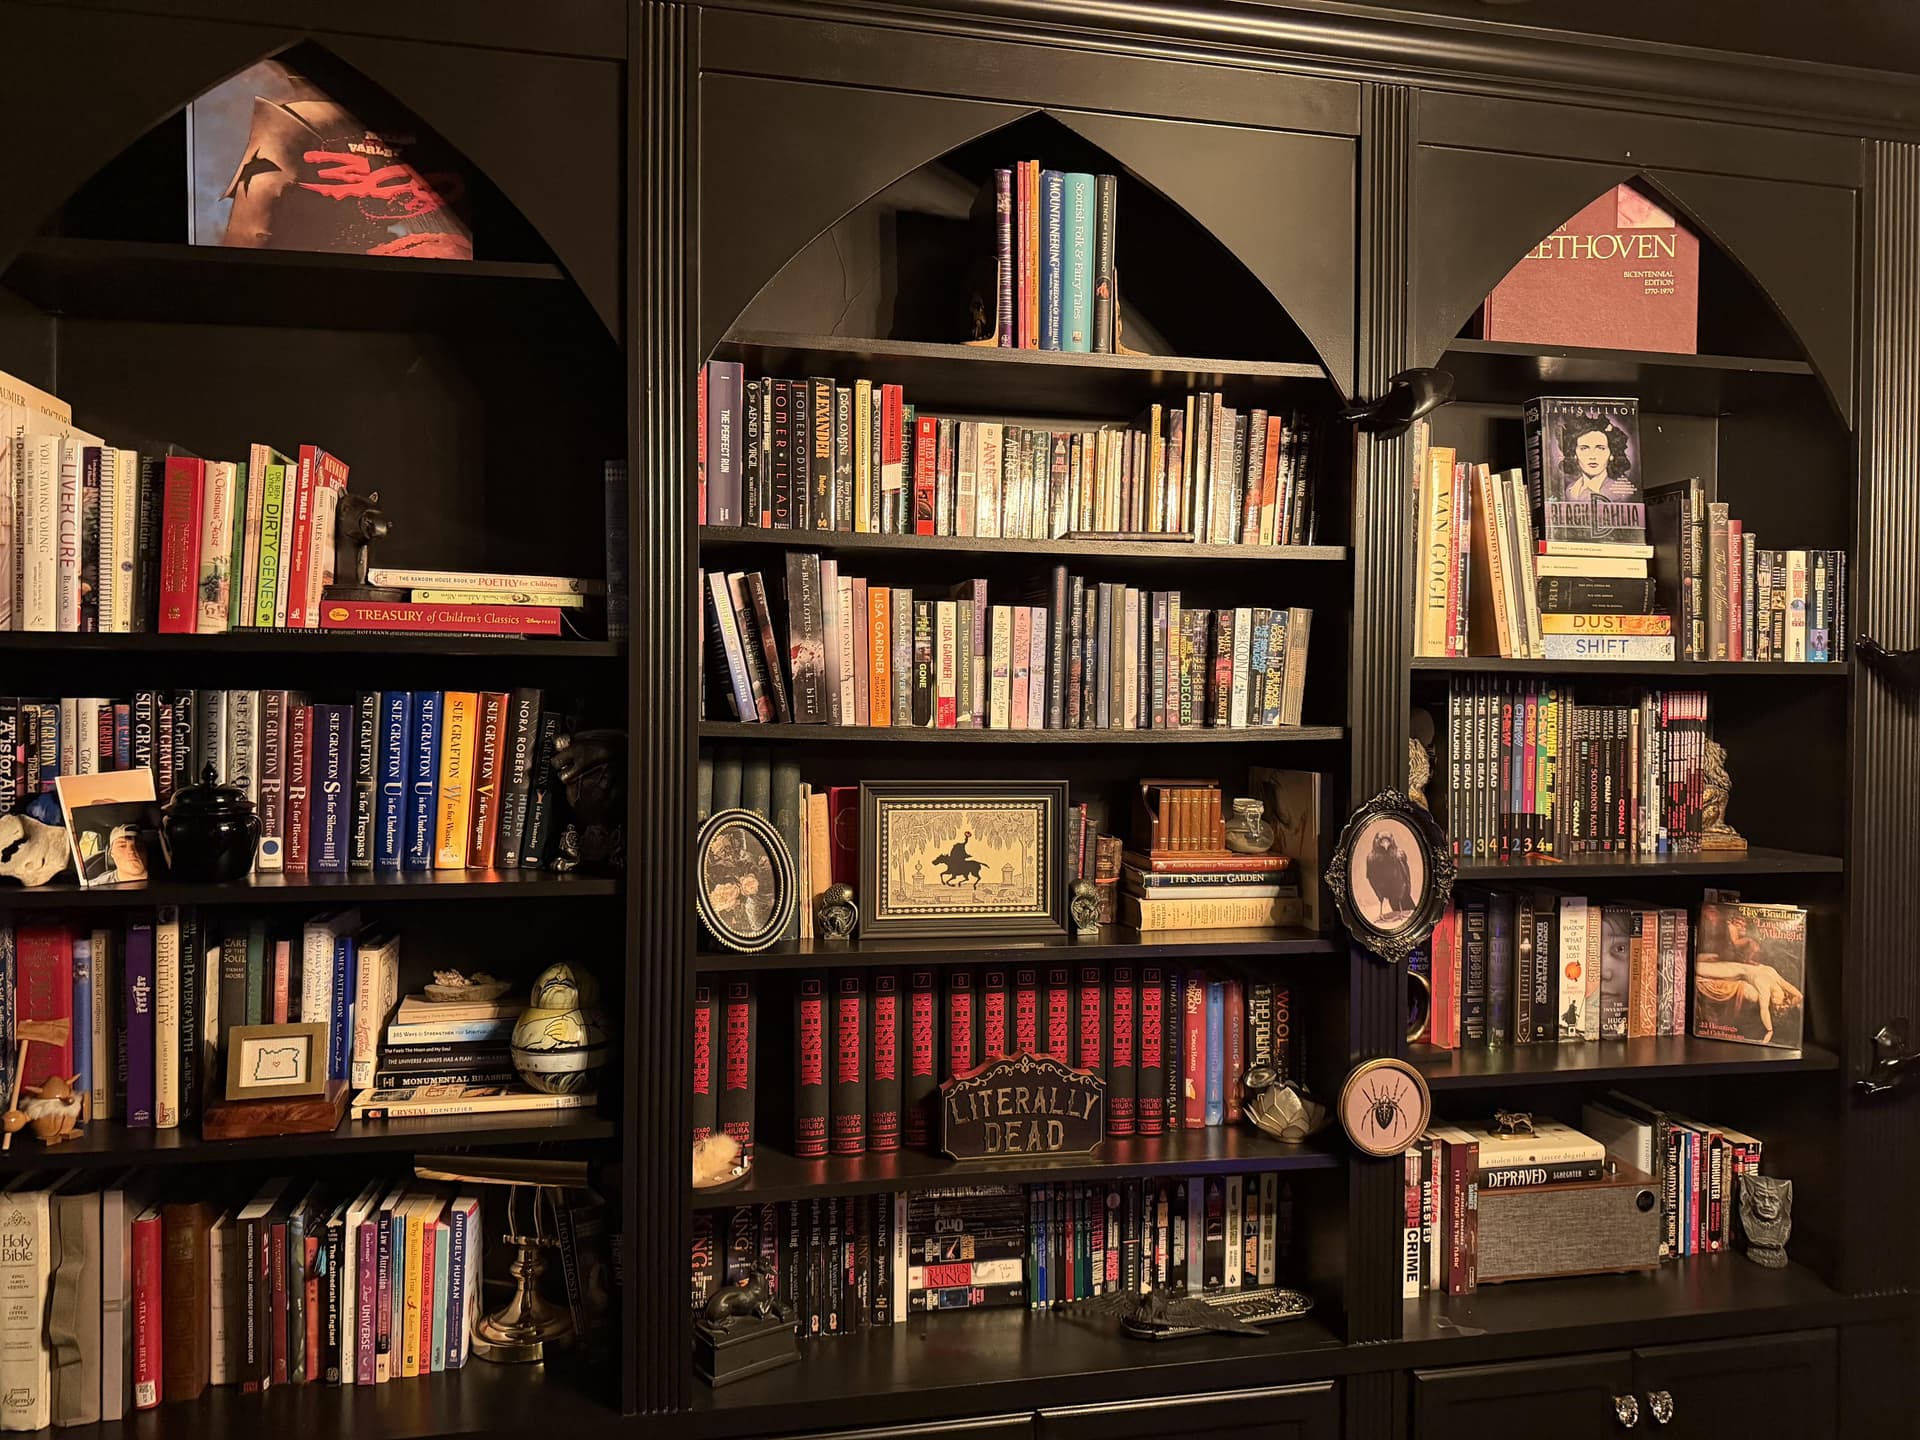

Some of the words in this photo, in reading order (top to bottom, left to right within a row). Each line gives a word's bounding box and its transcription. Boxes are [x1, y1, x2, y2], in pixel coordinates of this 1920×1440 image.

[1074, 182, 1084, 223] Scottish
[1049, 181, 1061, 267] MOUNTAINEERING
[1074, 225, 1084, 247] Folk
[1074, 250, 1083, 259] &
[1524, 234, 1677, 259] ETHOVEN
[1071, 262, 1083, 289] Fairy
[1644, 287, 1674, 295] 1770-1970
[1073, 292, 1082, 320] Tales
[721, 409, 730, 424] THE
[747, 405, 758, 438] AENEID
[775, 383, 787, 448] HOMER
[796, 391, 805, 437] HOMER
[815, 382, 830, 459] ALEXANDER
[15, 424, 24, 437] The
[720, 424, 730, 458] PERFECT
[15, 442, 24, 477] Doctor's
[39, 443, 49, 467] YOU:
[64, 447, 73, 461] THE
[720, 458, 729, 473] RUN
[747, 441, 757, 469] VIRGIL
[15, 478, 24, 497] Book
[267, 473, 275, 497] LYNCH
[301, 458, 311, 488] NEVADA
[796, 446, 805, 501] ODYSSEY
[817, 474, 827, 496] Dodge
[39, 470, 49, 513] STAYING
[60, 463, 75, 514] LIVER
[273, 484, 281, 500] BEN
[775, 463, 787, 518] ILIAD
[15, 502, 24, 510] of
[298, 491, 309, 521] TRAILS
[1433, 491, 1449, 532] VAN
[1551, 503, 1589, 526] BLACK
[15, 510, 24, 546] Survival
[39, 515, 49, 553] YOUNG
[264, 503, 279, 551] DIRTY
[297, 525, 305, 550] Western
[314, 514, 323, 541] WALES
[1683, 512, 1691, 545] DEVILS
[15, 547, 24, 571] Home
[59, 520, 76, 569] CURE
[1683, 547, 1691, 571] ROSE
[1732, 534, 1741, 556] Blood
[295, 551, 303, 572] Region
[801, 558, 809, 570] The
[1732, 558, 1740, 593] Meridian
[260, 555, 273, 609] GENES
[478, 578, 519, 588] POETRY
[519, 580, 529, 588] for
[530, 580, 558, 589] Children
[801, 572, 810, 601] BLACK
[1428, 543, 1447, 610] GOGH
[15, 573, 24, 613] Remedies
[62, 575, 72, 610] BLAYLOCK
[874, 592, 885, 617] LISA
[355, 608, 423, 622] TREASURY
[427, 612, 437, 624] of
[438, 611, 481, 624] Children's
[484, 612, 520, 625] Classics
[802, 602, 812, 632] LOTUS
[1054, 620, 1062, 640] THE
[1573, 615, 1626, 629] DUST
[874, 621, 885, 674] GARDNER
[1053, 643, 1061, 676] NEVER
[1576, 639, 1629, 654] SHIFT
[918, 663, 927, 689] GONE
[1052, 679, 1060, 700] LIST
[391, 699, 402, 721] SUE
[806, 687, 815, 715] blair
[1180, 677, 1192, 724] DEGREE
[1490, 696, 1498, 715] THE
[293, 709, 305, 730] SUE
[518, 700, 530, 732] NORA
[1547, 702, 1557, 757] WATCHMEN
[388, 723, 402, 778] GRAFTON
[1490, 717, 1498, 758] WALKING
[291, 732, 304, 783] GRAFTON
[513, 737, 526, 784] ROBERTS
[383, 781, 402, 796] U
[1490, 761, 1498, 788] DEAD
[288, 785, 306, 801] R
[292, 801, 301, 809] is
[291, 810, 302, 824] for
[387, 804, 396, 815] for
[502, 792, 514, 838] NATURE
[515, 793, 528, 838] HIDDEN
[1617, 798, 1626, 835] CONAN
[290, 823, 301, 858] Ricochet
[385, 815, 396, 854] Undertow
[1169, 874, 1190, 884] THE
[1191, 873, 1225, 883] SECRET
[1227, 873, 1264, 883] GARDEN
[1536, 921, 1544, 951] EDGAR
[183, 944, 194, 965] THE
[337, 946, 345, 971] JAMES
[1535, 953, 1543, 983] ALLAN
[157, 933, 169, 1027] SPIRITUALITY
[183, 964, 195, 1006] POWER
[361, 956, 370, 986] GLENN
[335, 973, 345, 1018] PATTERSON
[360, 988, 369, 1011] BECK
[1535, 984, 1543, 1004] POE
[183, 1005, 193, 1017] OF
[183, 1017, 194, 1053] MYTH
[800, 1000, 822, 1088] BERSERK
[874, 996, 895, 1080] BERSERK
[402, 1075, 469, 1086] MONUMENTAL
[390, 1107, 426, 1116] CRYSTAL
[949, 1086, 1100, 1126] LITERALLY
[984, 1119, 1065, 1153] DEAD
[1668, 1146, 1677, 1162] THE
[1488, 1168, 1547, 1188] DEPRAVED
[1668, 1164, 1677, 1210] AMITYVILLE
[1710, 1148, 1721, 1200] MINDHUNTER
[380, 1219, 388, 1230] The
[1422, 1181, 1431, 1244] ARRESTED
[2, 1234, 32, 1250] Holy
[379, 1231, 389, 1245] Law
[453, 1213, 463, 1262] UNIQUELY
[1668, 1211, 1676, 1247] HORROR
[1, 1249, 33, 1262] Bible
[329, 1244, 337, 1259] The
[379, 1246, 387, 1254] of
[1407, 1230, 1418, 1283] CRIME
[328, 1260, 337, 1300] Cathedrals
[378, 1254, 388, 1290] Attraction
[452, 1264, 462, 1299] HUMAN
[928, 1265, 969, 1275] STEPHEN
[928, 1272, 969, 1286] KING
[328, 1301, 337, 1312] of
[327, 1313, 337, 1346] England
[361, 1304, 371, 1351] UNIVERSE
